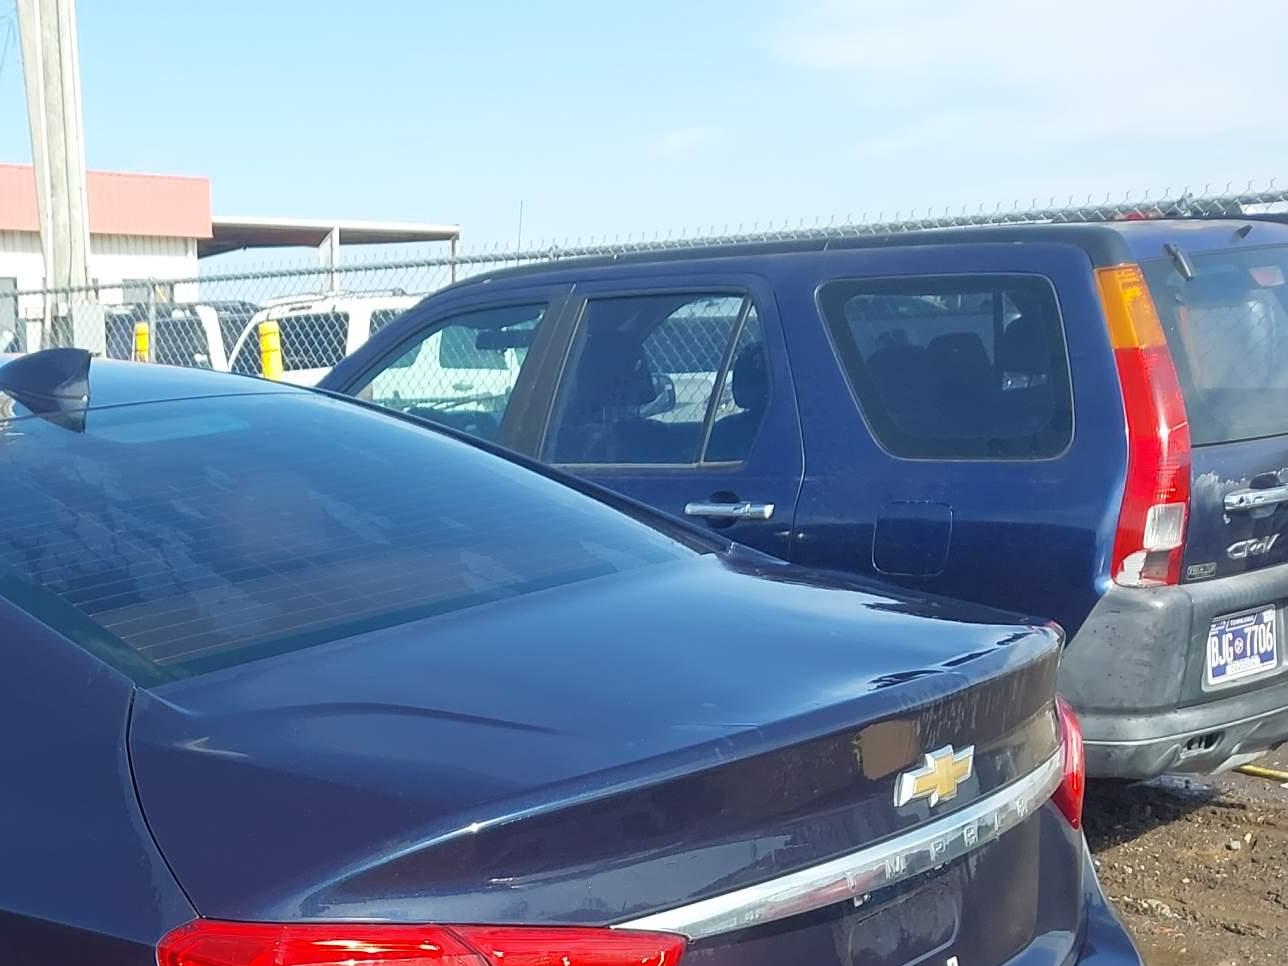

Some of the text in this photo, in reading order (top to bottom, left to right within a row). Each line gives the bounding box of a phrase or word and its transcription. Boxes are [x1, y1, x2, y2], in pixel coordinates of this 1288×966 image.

[1211, 632, 1234, 668] BJG
[1243, 621, 1274, 657] 7706
[845, 799, 1029, 890] IMPALA
